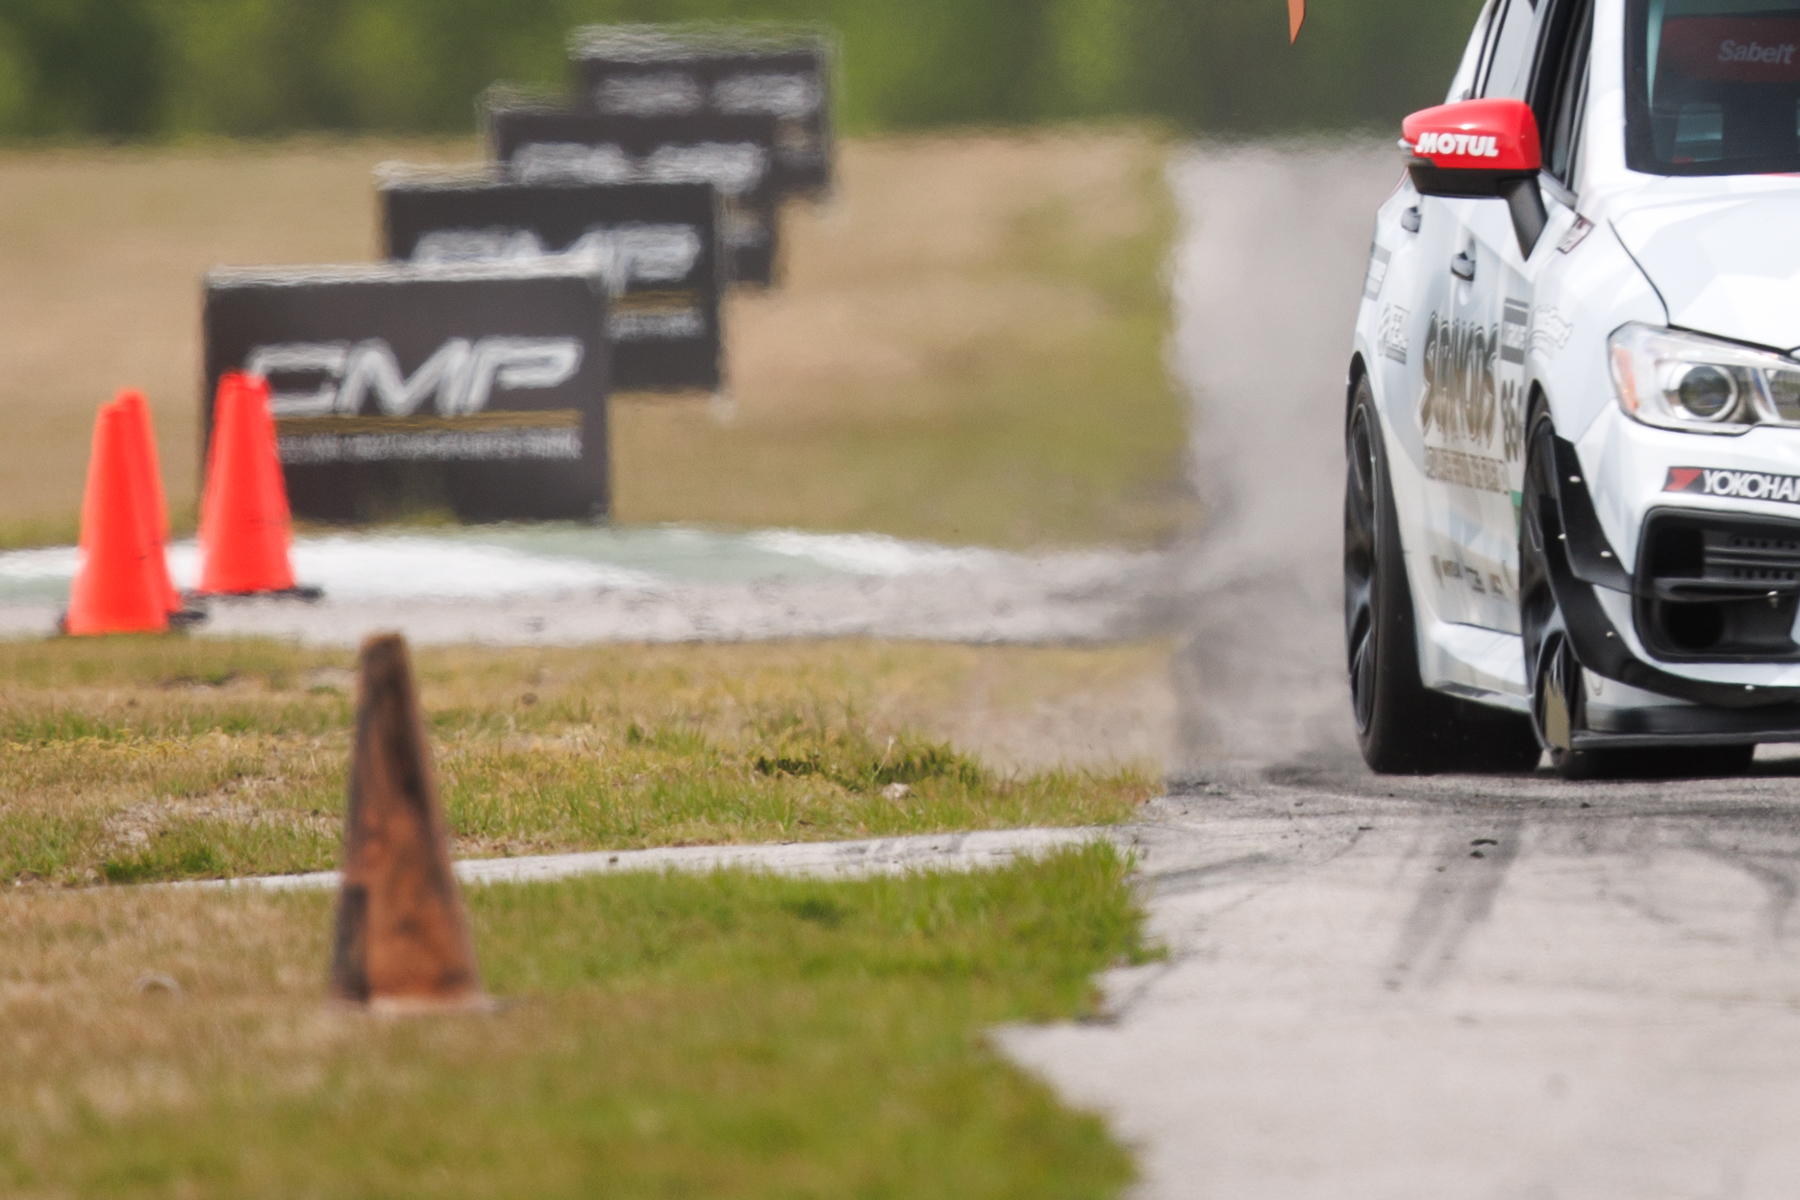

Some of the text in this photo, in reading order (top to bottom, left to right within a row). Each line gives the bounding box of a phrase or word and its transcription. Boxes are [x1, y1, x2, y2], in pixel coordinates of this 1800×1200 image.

[1718, 38, 1796, 65] Sabelt
[1415, 132, 1499, 157] MOTUL
[246, 336, 584, 418] CMP
